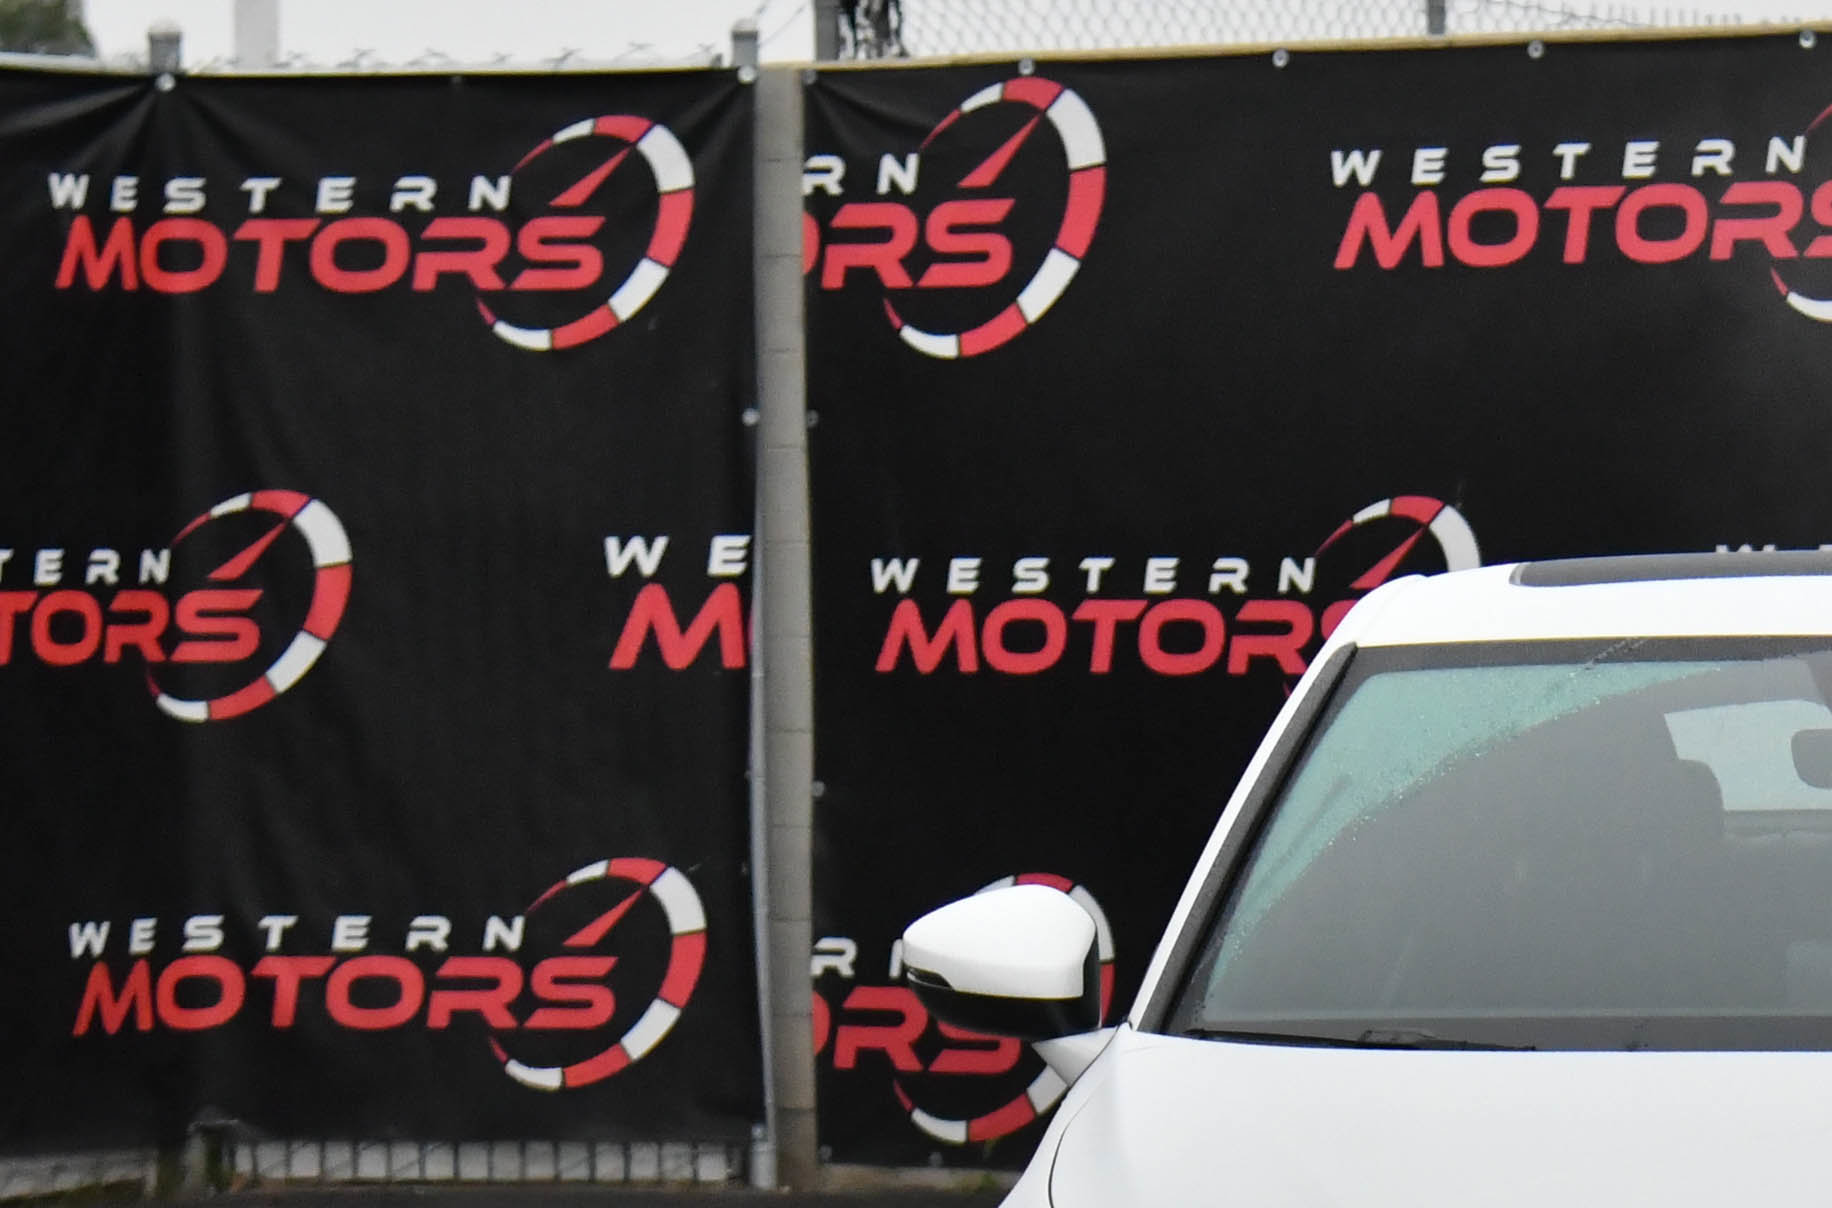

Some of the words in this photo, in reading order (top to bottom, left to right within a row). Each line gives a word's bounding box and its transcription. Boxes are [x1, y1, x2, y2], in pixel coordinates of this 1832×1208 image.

[49, 173, 512, 213] WESTERN
[1330, 135, 1807, 186] WESTERN
[55, 215, 605, 294] MOTORS
[802, 199, 1015, 290] RS
[871, 557, 1316, 593] WESTERN
[609, 583, 752, 670] M
[875, 598, 1357, 676] MOTOR
[70, 915, 525, 958] WESTERN
[74, 955, 618, 1036] MOTORS
[812, 986, 1021, 1075] RS
